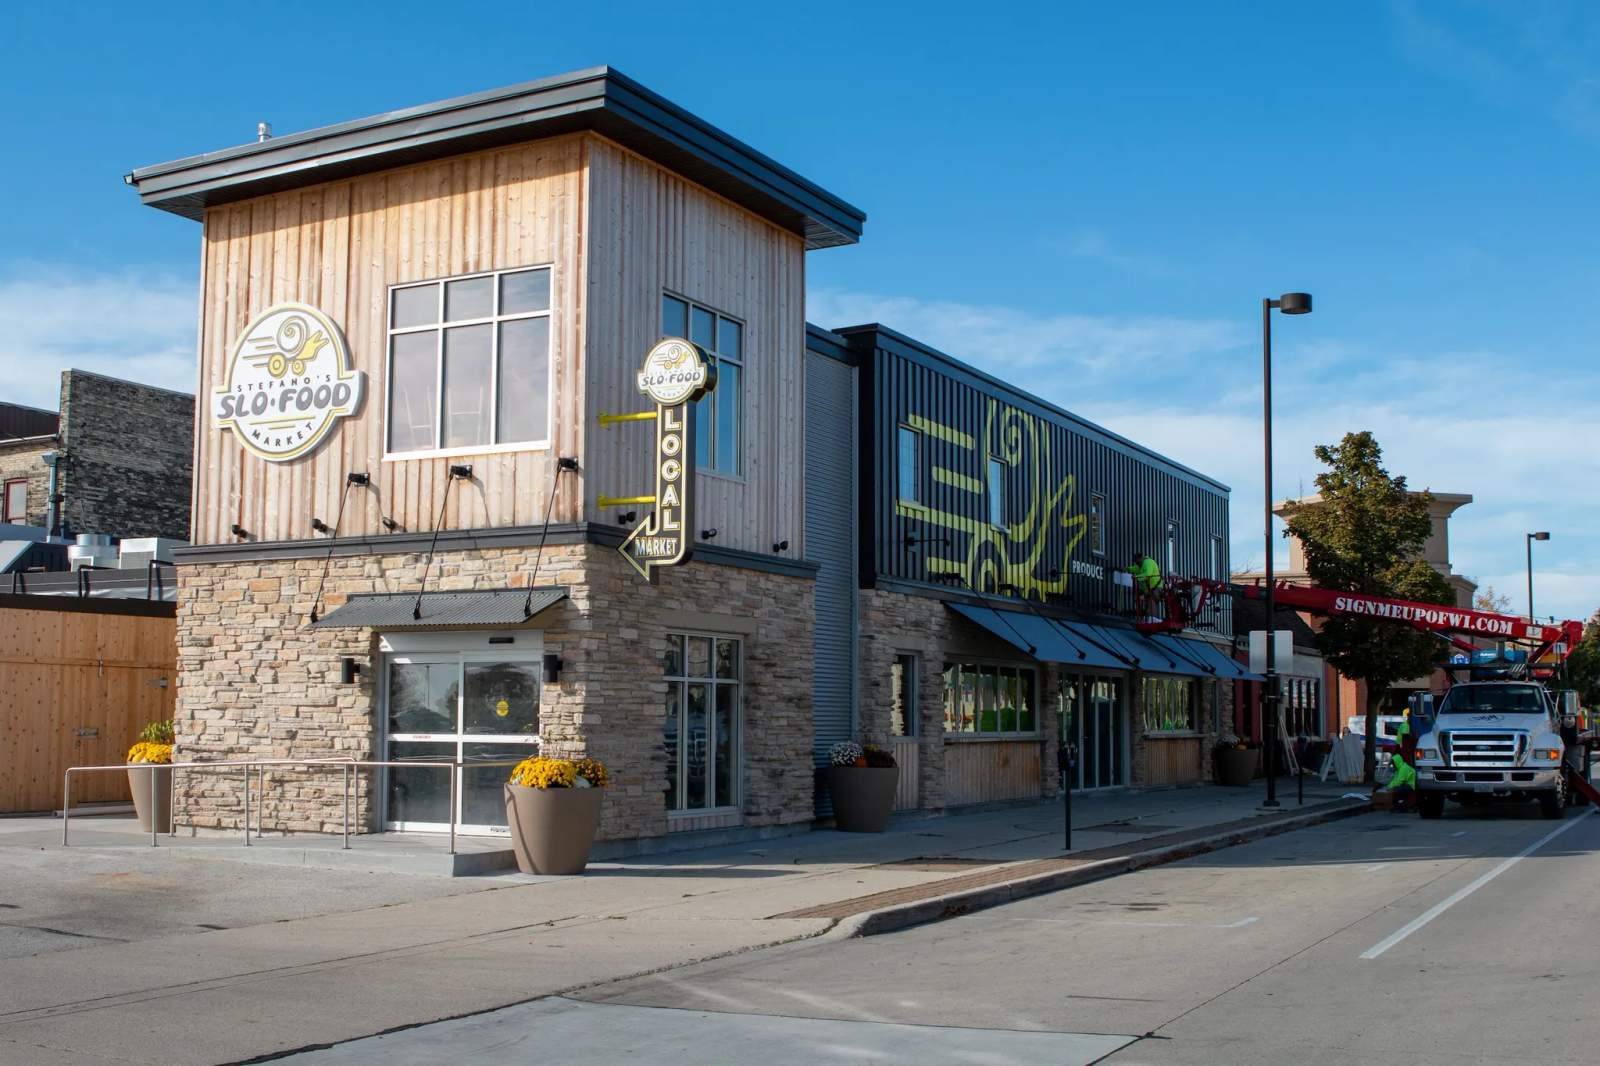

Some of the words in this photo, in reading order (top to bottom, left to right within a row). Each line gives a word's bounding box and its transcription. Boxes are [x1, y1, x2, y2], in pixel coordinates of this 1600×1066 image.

[237, 374, 332, 393] STEFANO'S
[252, 422, 313, 447] MARKET
[661, 408, 682, 531] LOCAL
[634, 536, 678, 557] MARKET
[1072, 559, 1104, 580] PRODUCE
[1335, 597, 1513, 635] SIGNMEUPOFWI.COM
